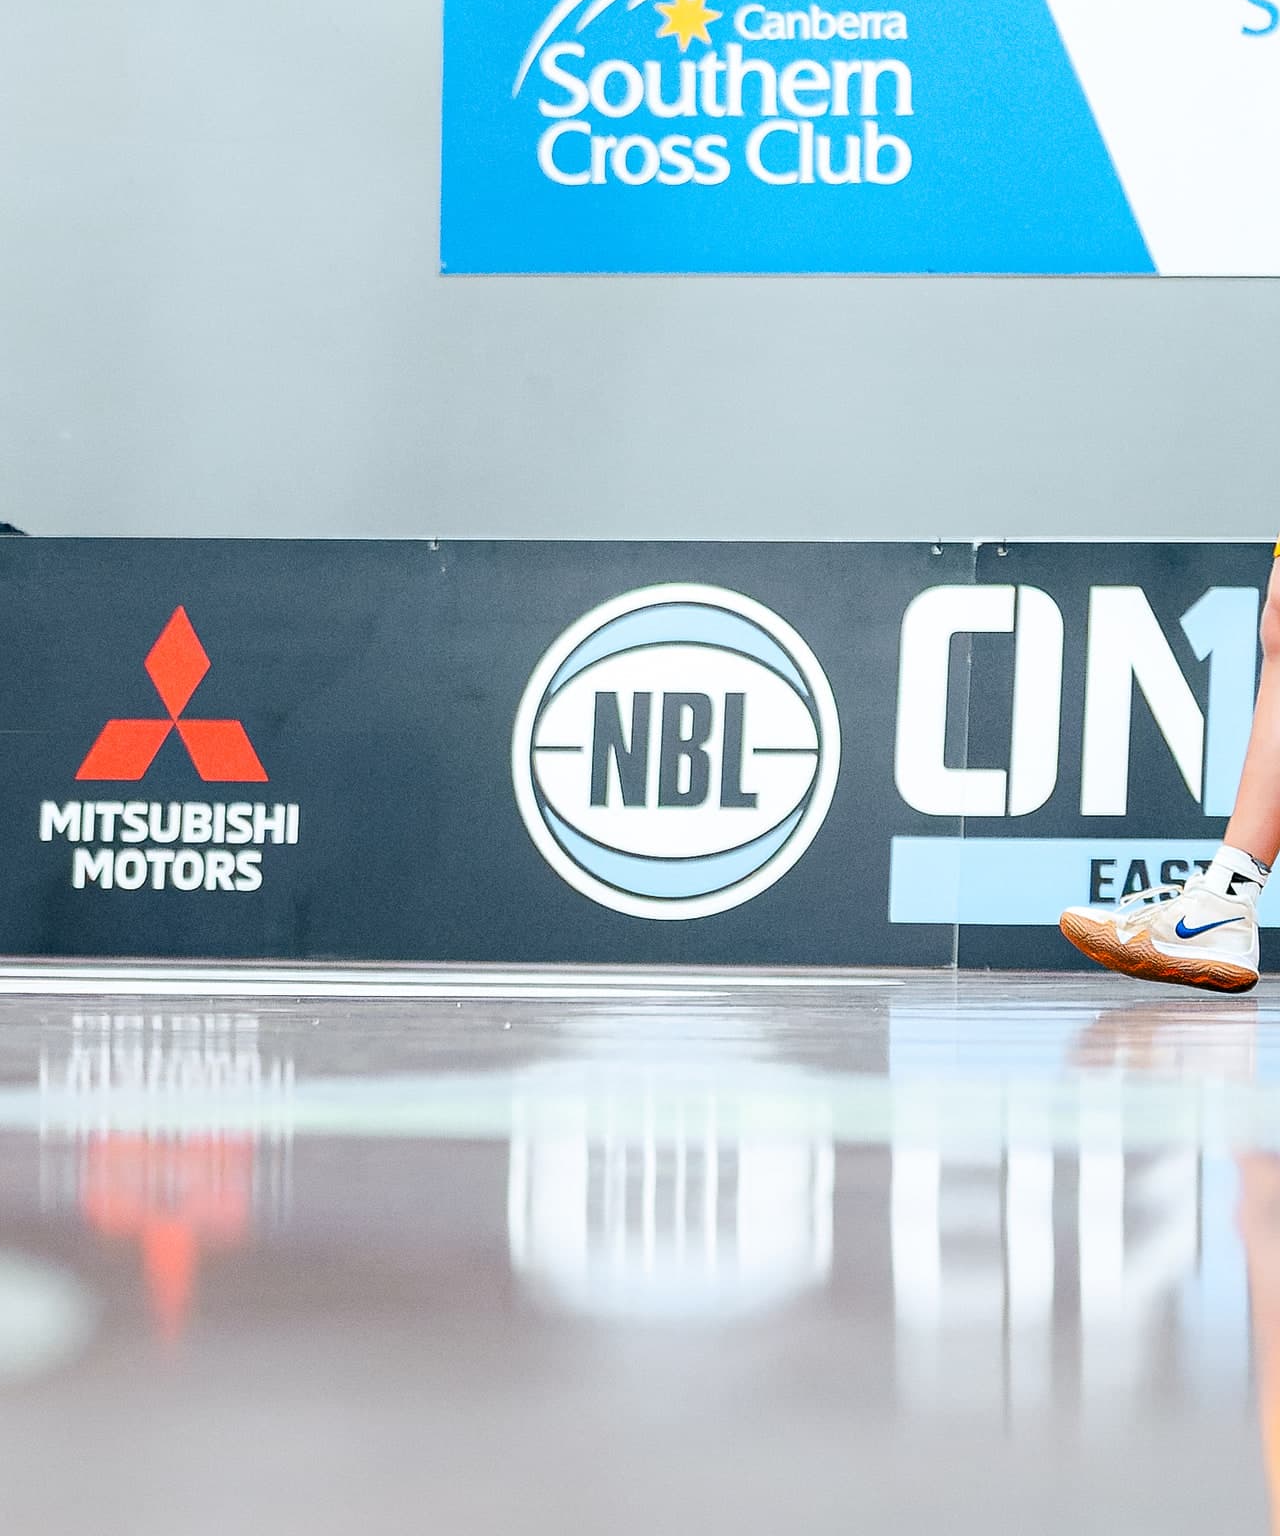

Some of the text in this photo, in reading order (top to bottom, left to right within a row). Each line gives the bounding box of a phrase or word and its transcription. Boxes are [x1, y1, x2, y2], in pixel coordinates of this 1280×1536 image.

[735, 3, 908, 41] Canberra
[538, 41, 915, 119] Southern
[537, 119, 914, 186] Cross Club
[590, 690, 759, 809] NBL
[39, 800, 300, 845] MITSUBISHI
[71, 847, 264, 892] MOTORS
